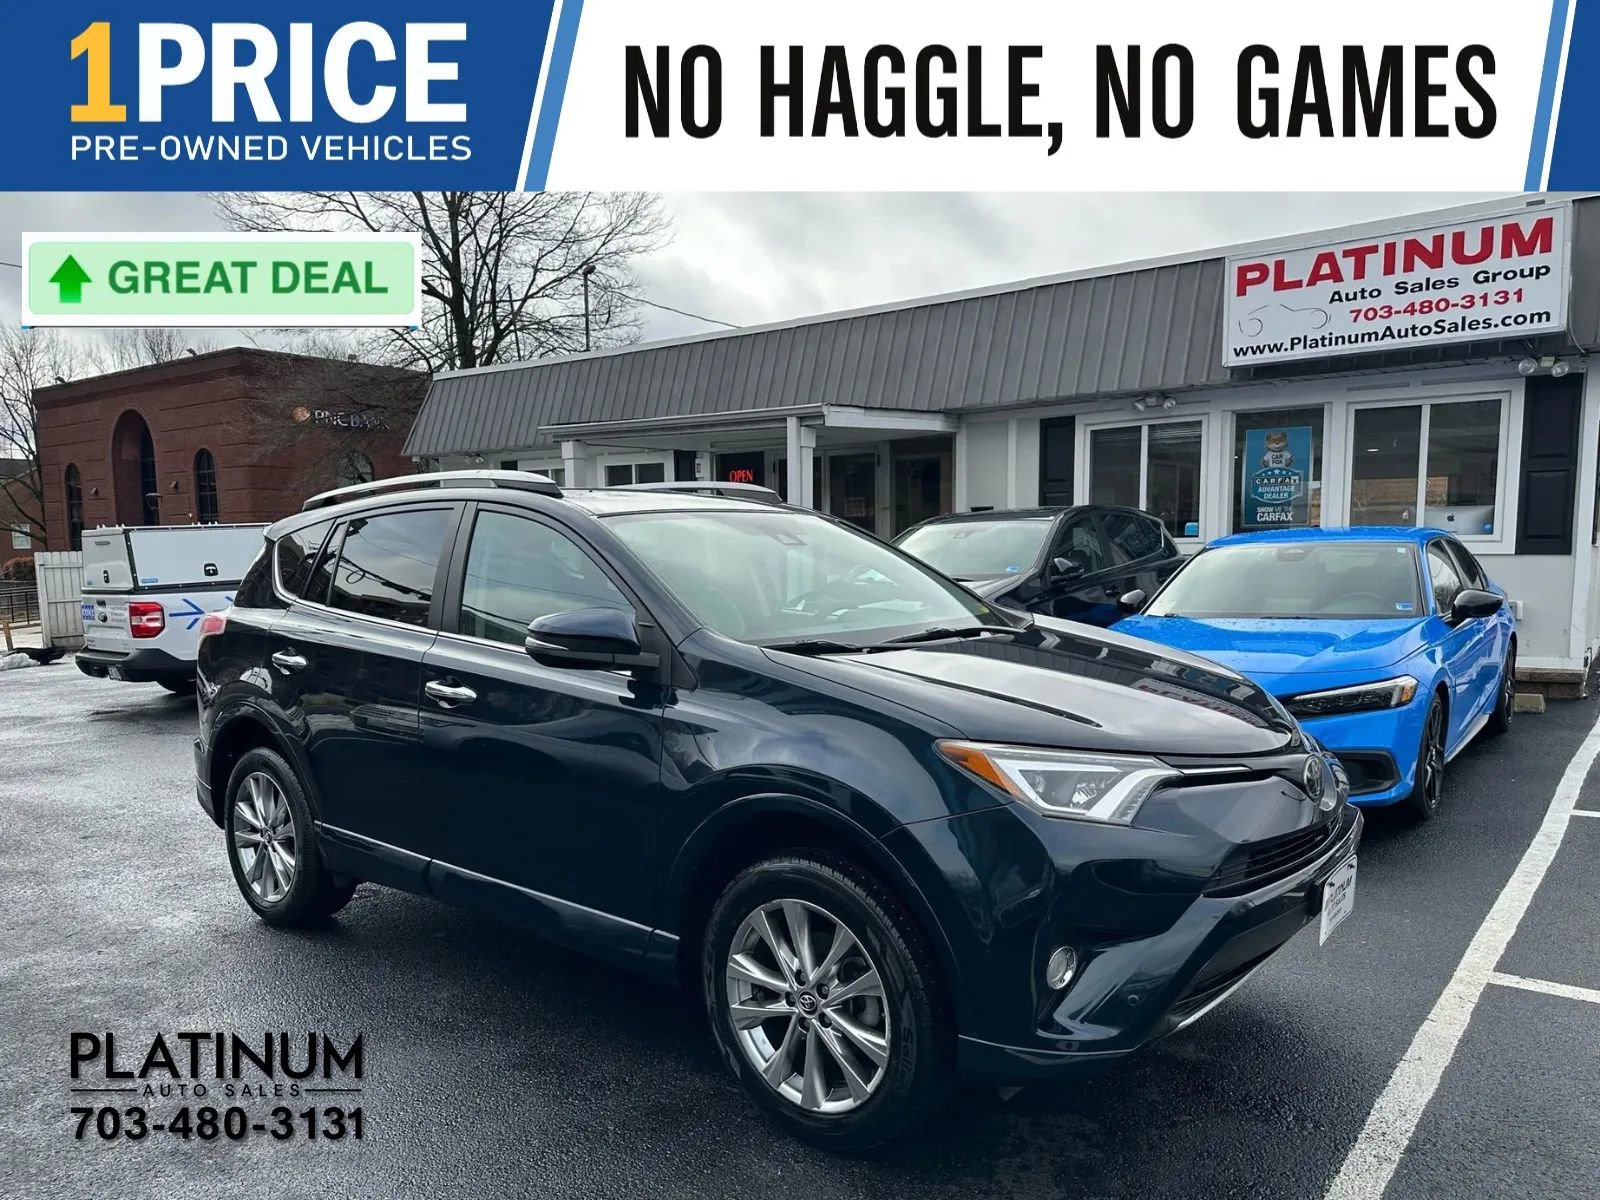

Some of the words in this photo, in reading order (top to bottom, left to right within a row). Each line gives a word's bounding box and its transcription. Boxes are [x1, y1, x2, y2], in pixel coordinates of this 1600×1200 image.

[1236, 217, 1554, 297] PLATINUM
[1328, 286, 1382, 305] Auto
[1393, 275, 1460, 295] Sales
[1472, 263, 1551, 286] Group
[1349, 288, 1524, 323] 703-480-3131
[1233, 309, 1551, 358] www.PlatinumAutoSales.com
[729, 469, 753, 483] OPEN
[1256, 512, 1293, 522] CARFAX
